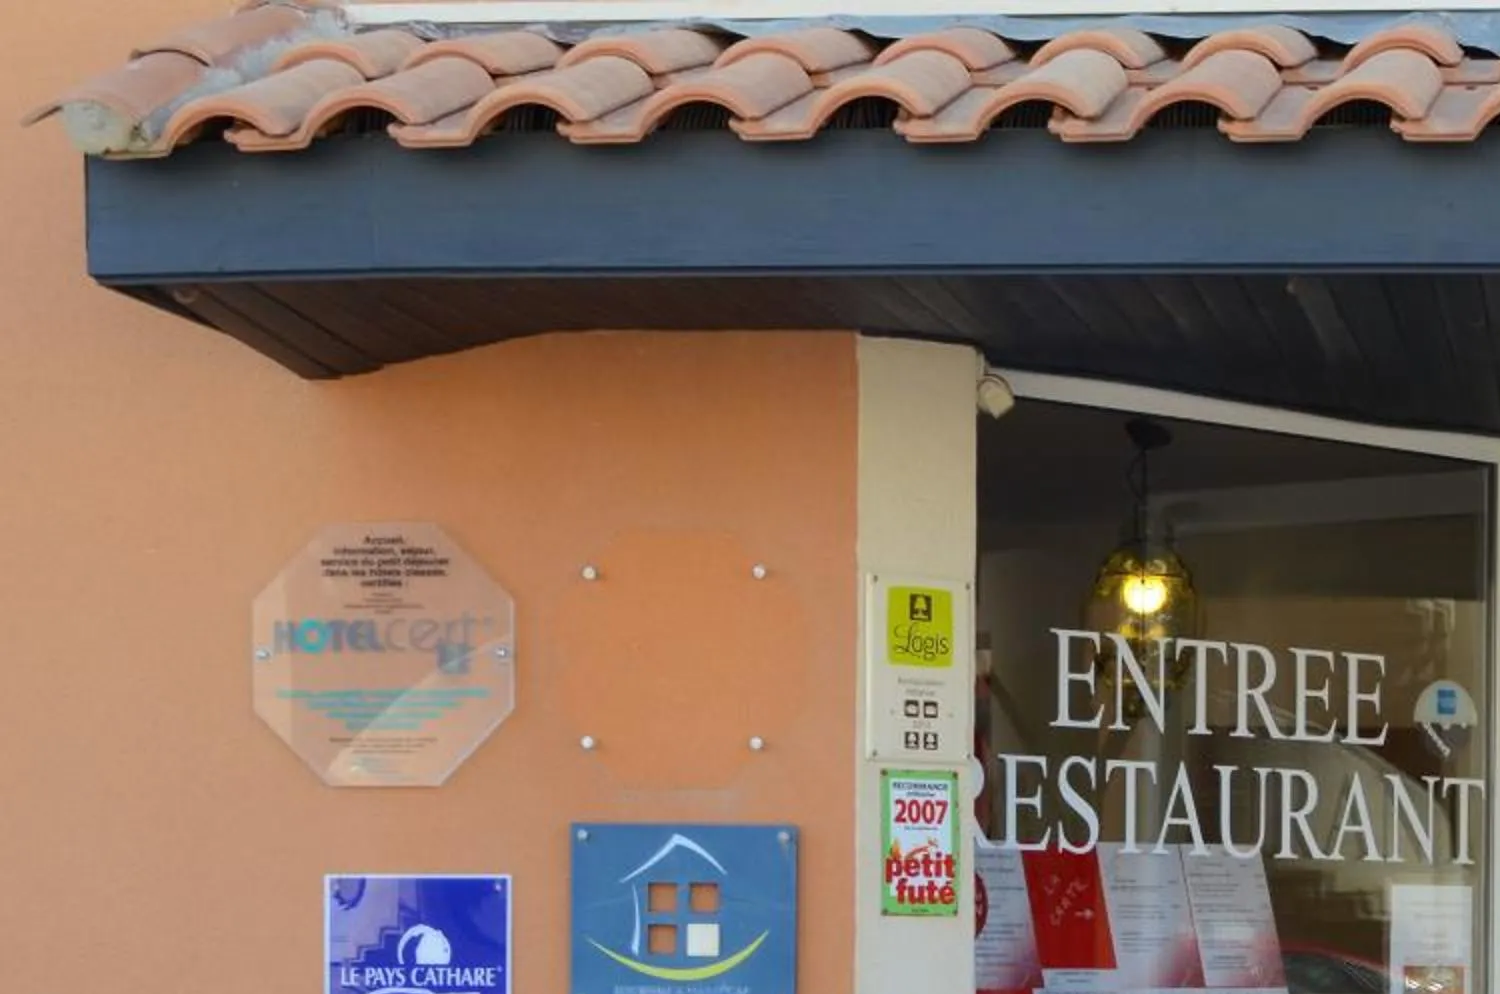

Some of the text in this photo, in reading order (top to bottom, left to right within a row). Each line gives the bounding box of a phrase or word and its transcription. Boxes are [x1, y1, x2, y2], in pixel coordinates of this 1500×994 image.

[893, 622, 949, 662] Logis
[1050, 627, 1389, 746] ENTREE
[894, 798, 948, 825] 2007
[885, 852, 955, 883] petit
[897, 877, 955, 904] futé
[341, 967, 496, 987] LE PAYS CATHARE
